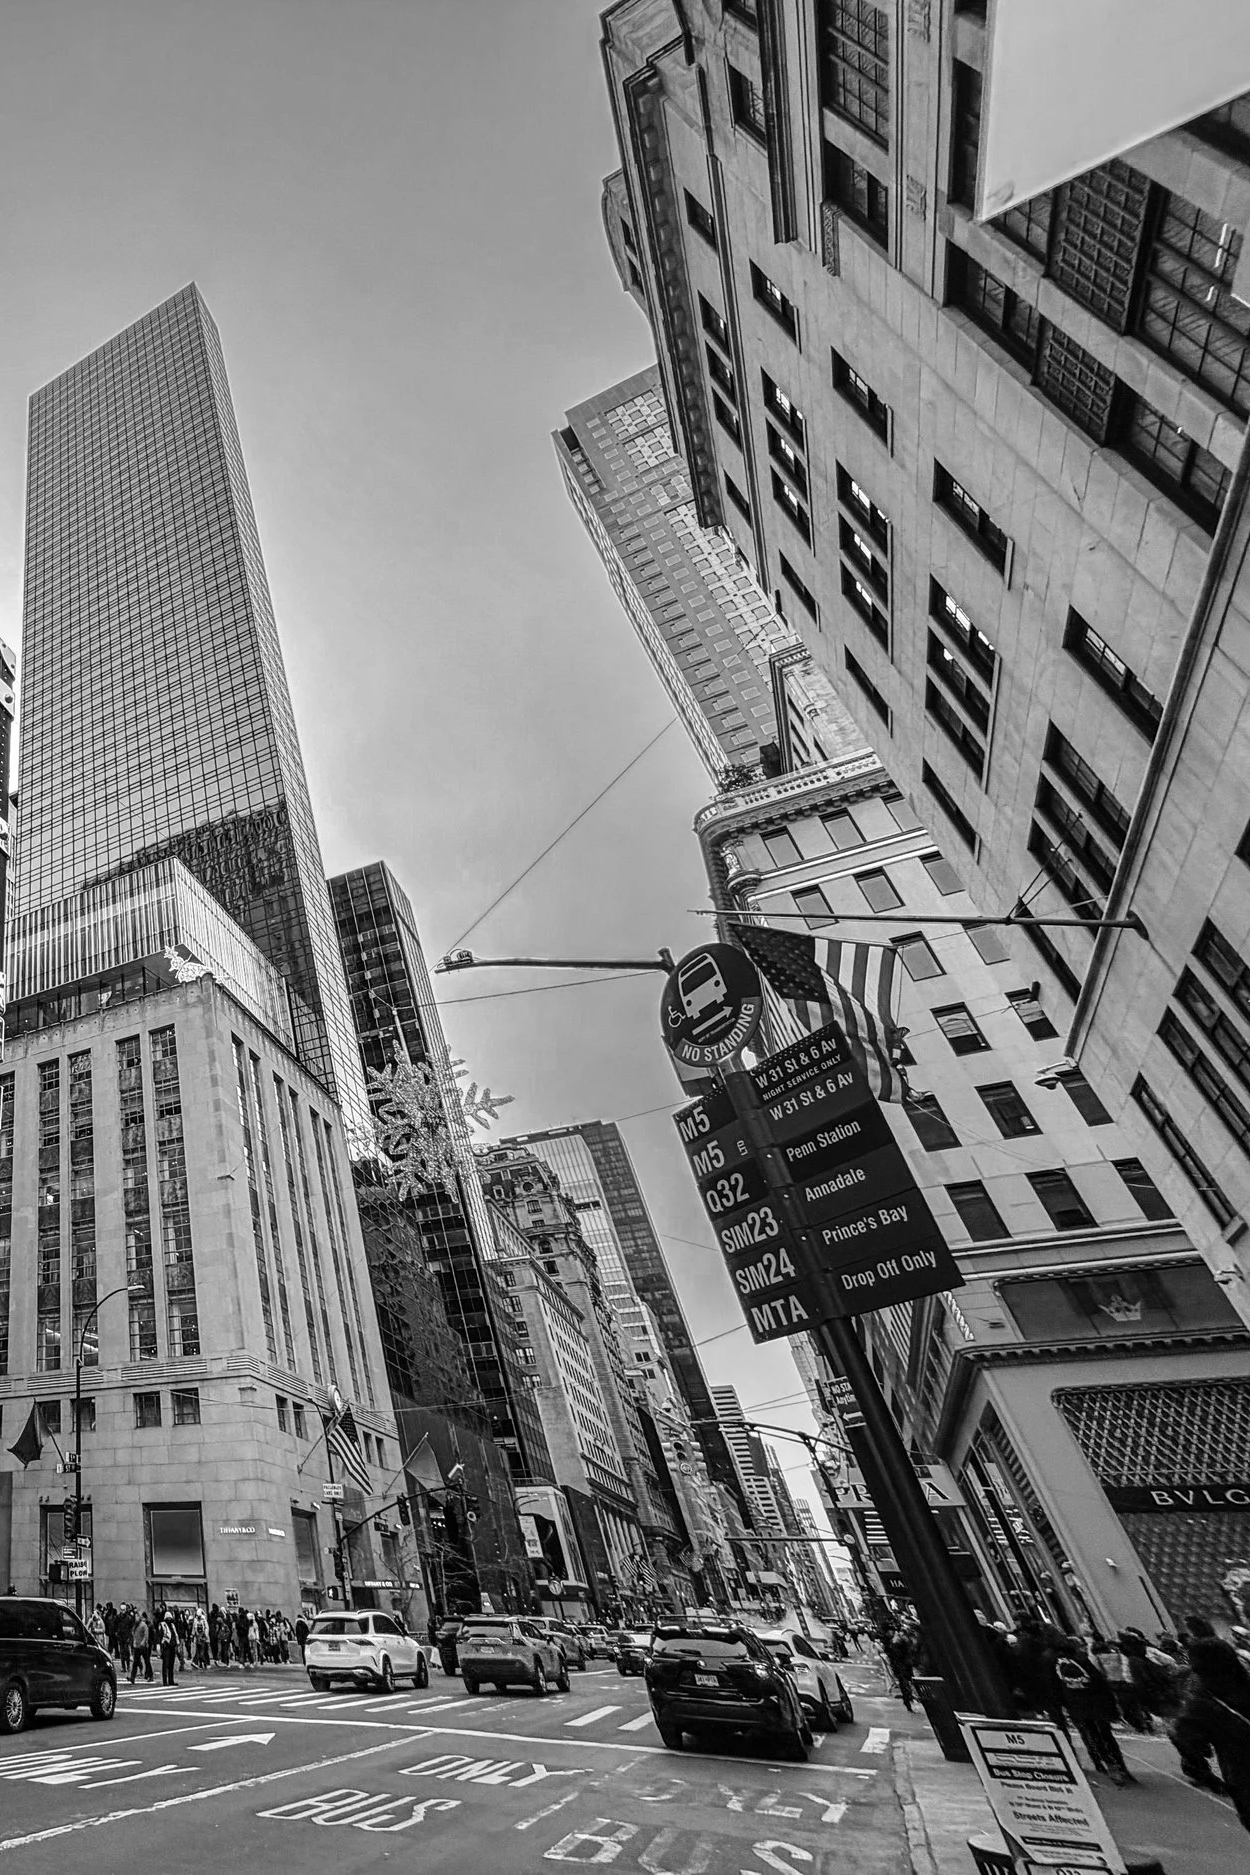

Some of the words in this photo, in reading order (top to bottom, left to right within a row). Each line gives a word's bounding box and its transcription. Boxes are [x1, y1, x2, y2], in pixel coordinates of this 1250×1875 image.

[681, 1044, 700, 1062] NO
[703, 1003, 755, 1062] STANDING
[755, 1073, 769, 1089] W
[769, 1065, 784, 1082] 31
[784, 1058, 799, 1073] St
[799, 1052, 811, 1065] &
[810, 1046, 820, 1059] 6
[821, 1038, 837, 1054] Av
[762, 1084, 786, 1101] NIGHT
[786, 1066, 820, 1088] SERVICE
[820, 1054, 841, 1070] ONLY
[769, 1105, 784, 1120] W
[783, 1097, 799, 1114] 31
[799, 1090, 815, 1106] St
[814, 1085, 826, 1099] &
[826, 1079, 837, 1093] 6
[837, 1072, 854, 1088] Av
[679, 1105, 710, 1142] M5
[786, 1140, 817, 1162] Penn
[816, 1120, 861, 1148] Station
[692, 1139, 725, 1177] M5
[736, 1140, 749, 1156] LTD
[706, 1172, 750, 1213] Q32
[805, 1168, 866, 1202] Annadale
[721, 1206, 779, 1253] SIM23
[822, 1216, 878, 1245] Prince's
[878, 1205, 908, 1225] Bay
[735, 1247, 796, 1294] SIM24
[841, 1270, 876, 1290] Drop
[876, 1259, 900, 1279] Off
[901, 1250, 937, 1272] Only
[750, 1295, 809, 1333] MTA
[833, 1482, 951, 1502] PRA
[1005, 1733, 1025, 1745] M5
[398, 1755, 593, 1787] ONLY
[256, 1788, 462, 1831] BUS
